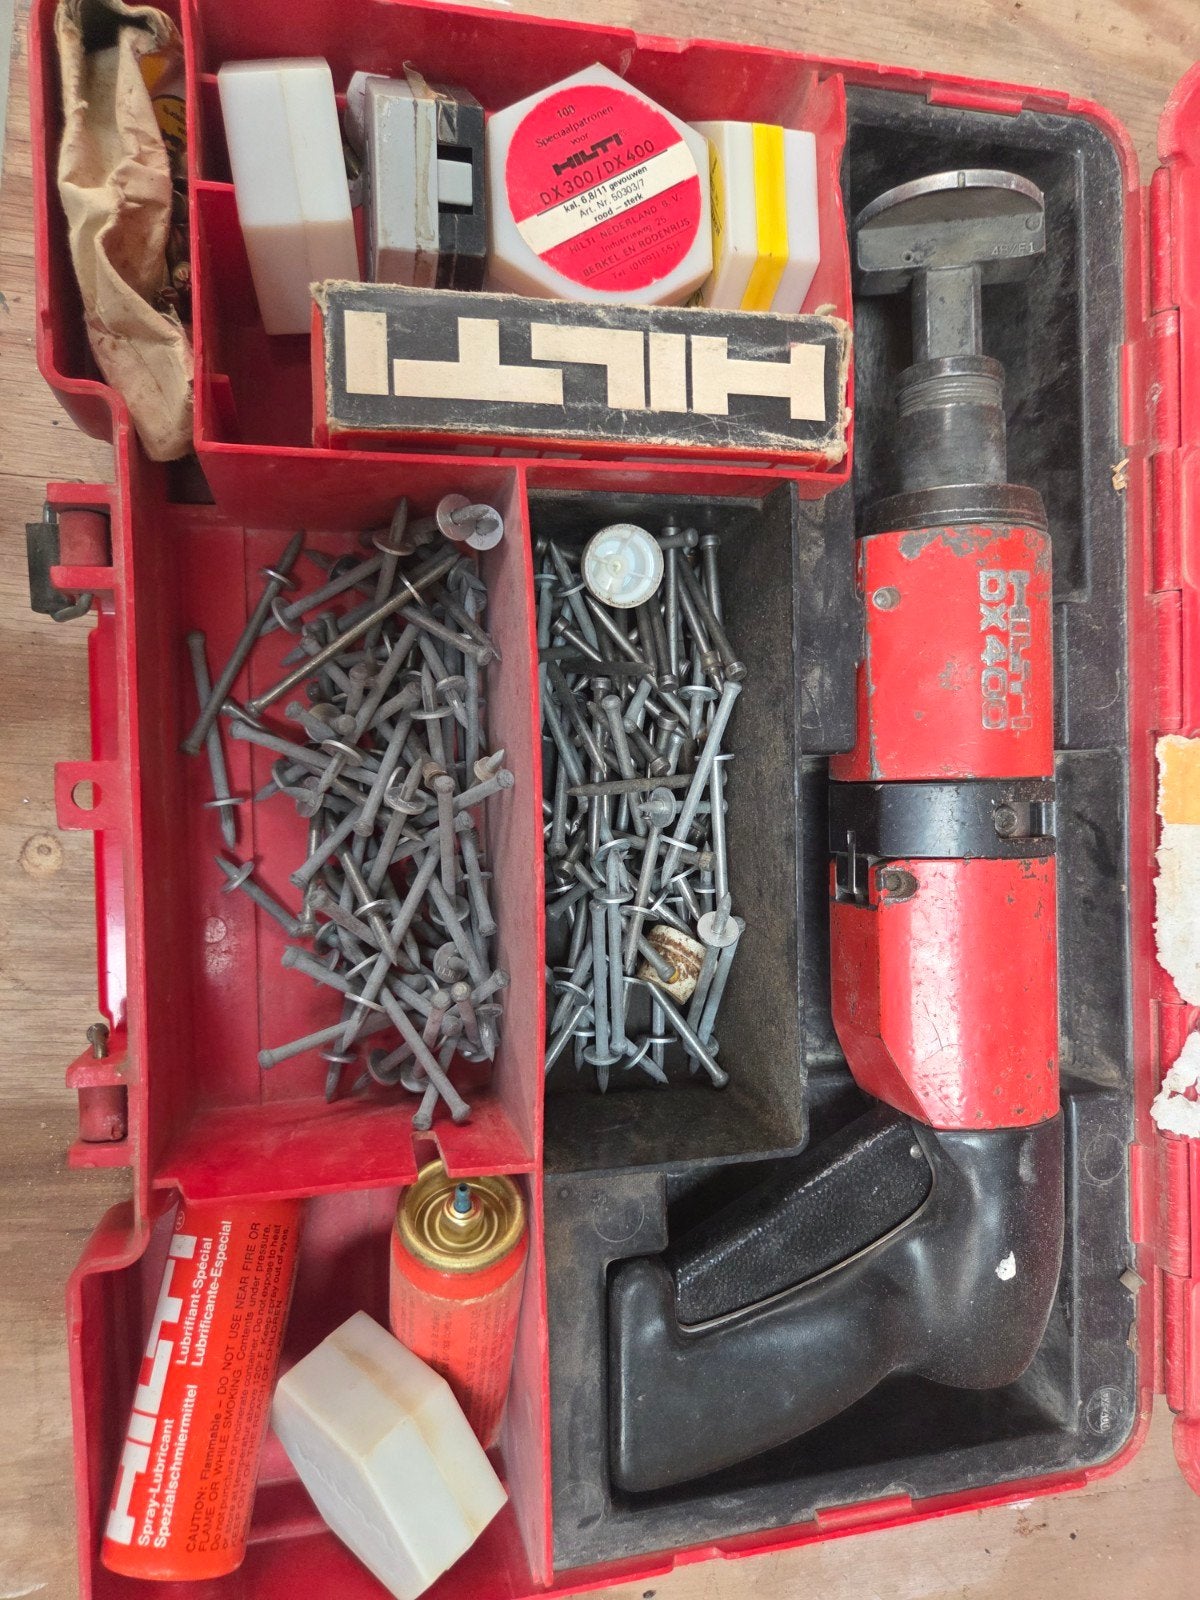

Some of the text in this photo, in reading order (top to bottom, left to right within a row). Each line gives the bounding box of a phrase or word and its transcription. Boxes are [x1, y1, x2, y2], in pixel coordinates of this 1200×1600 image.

[534, 102, 615, 150] Speciaalpatronen
[556, 103, 576, 120] 100
[551, 132, 623, 176] HILTI
[569, 131, 589, 146] voor
[562, 164, 649, 213] kal. 6,8/11 gevouwen
[577, 177, 646, 218] Art. Nr. 50303/7
[592, 206, 614, 222] rood
[621, 191, 643, 207] sterk
[568, 235, 596, 254] HILTI
[598, 204, 658, 239] NEDERLAND
[670, 191, 682, 203] V.
[600, 222, 652, 254] Industrieweg
[581, 216, 691, 277] BERKEL EN RODENRIJS
[344, 310, 826, 421] HILTI
[1008, 569, 1032, 730] HILTI
[247, 1220, 261, 1240] OR
[253, 1222, 273, 1272] pressure.
[269, 1222, 282, 1247] heat
[278, 1224, 290, 1253] eyes.
[241, 1242, 256, 1272] FIRE
[266, 1247, 276, 1259] to
[233, 1274, 249, 1310] NEAR
[246, 1274, 261, 1307] under
[259, 1260, 276, 1298] expose
[271, 1265, 282, 1283] out
[174, 1236, 215, 1366] Lubrifiant-Spécial
[190, 1219, 235, 1368] Lubrificante-Especial
[255, 1298, 266, 1316] not
[265, 1284, 279, 1314] spray
[227, 1313, 242, 1340] USE
[235, 1310, 254, 1361] Contents
[251, 1316, 263, 1333] Do
[259, 1315, 272, 1345] Keep
[221, 1343, 236, 1371] NOT
[260, 1362, 270, 1382] OF
[103, 1230, 197, 1546] HILTI
[216, 1374, 229, 1395] DO
[230, 1388, 250, 1442] incinerate
[244, 1387, 259, 1423] above
[199, 1411, 222, 1481] Flammable
[211, 1432, 229, 1477] WHILE
[229, 1444, 238, 1456] or
[136, 1416, 178, 1547] Spray-Lubricant
[151, 1382, 202, 1549] Spezialschmiermittel
[217, 1457, 238, 1510] puncture
[207, 1479, 220, 1502] OR
[184, 1485, 208, 1553] CAUTION:
[196, 1503, 216, 1553] FLAME
[213, 1511, 225, 1531] not
[209, 1531, 221, 1551] Do
